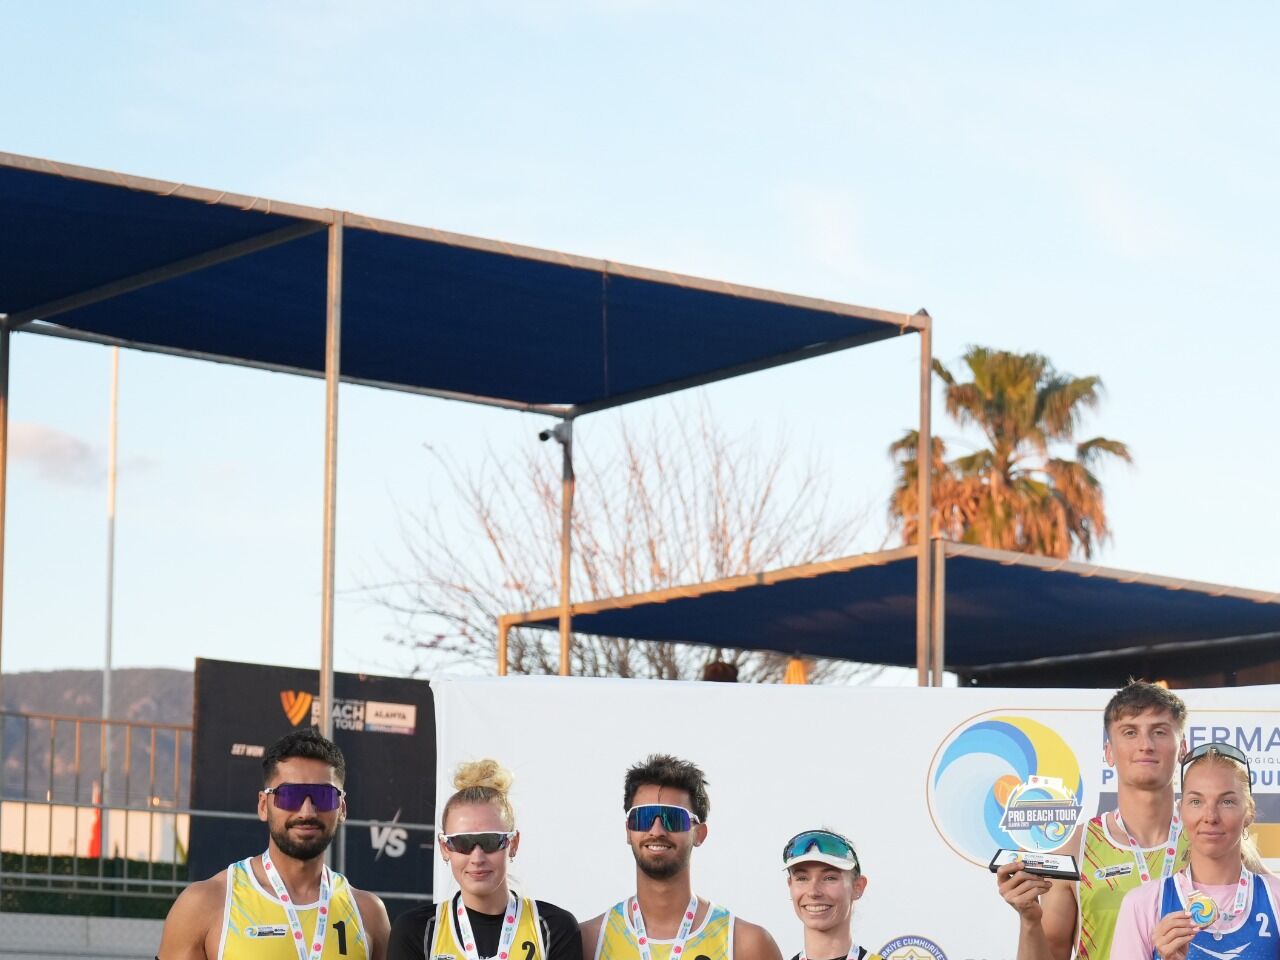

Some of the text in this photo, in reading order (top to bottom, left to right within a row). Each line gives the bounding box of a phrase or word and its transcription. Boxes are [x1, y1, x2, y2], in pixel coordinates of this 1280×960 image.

[311, 700, 364, 720] BACH
[1007, 808, 1077, 823] PRO BEACH TOUR
[370, 824, 408, 857] VS
[1255, 912, 1272, 937] 2
[332, 920, 348, 956] 1
